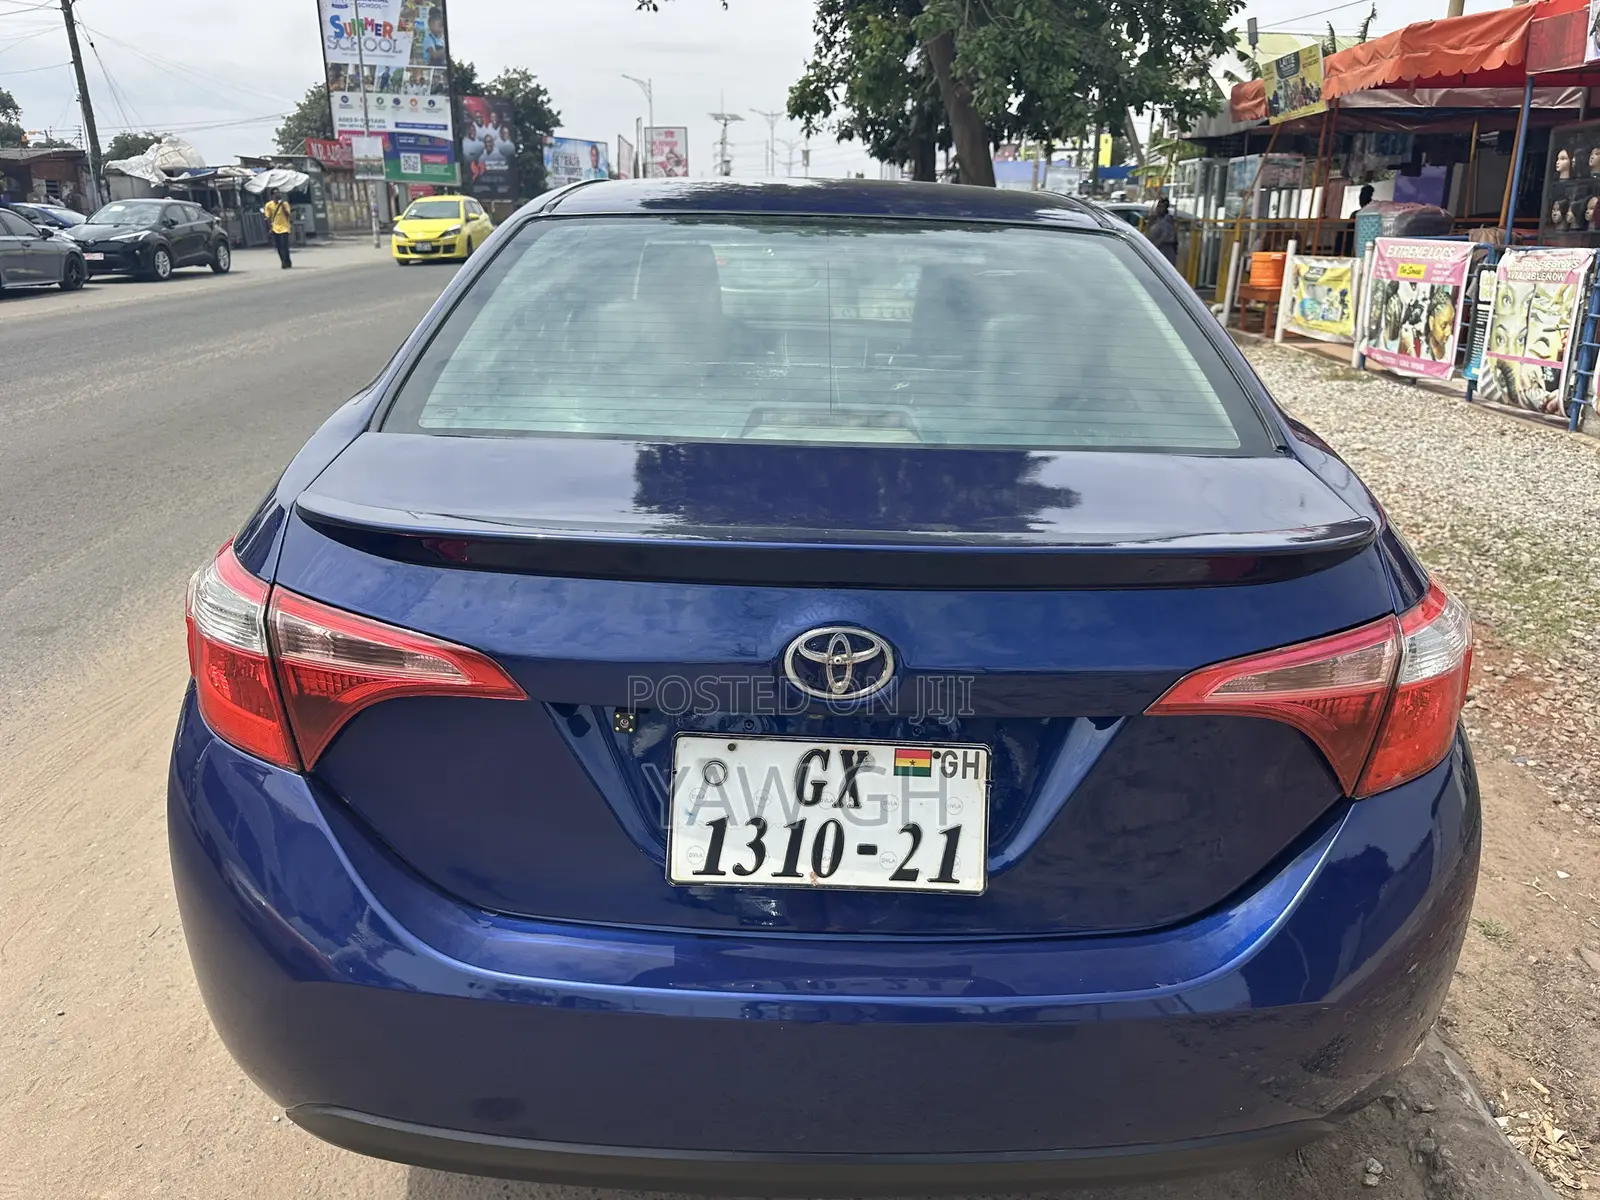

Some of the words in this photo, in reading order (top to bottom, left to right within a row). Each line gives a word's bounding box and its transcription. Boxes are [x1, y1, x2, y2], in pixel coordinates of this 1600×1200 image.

[329, 14, 394, 40] SUMMER
[795, 748, 869, 809] GX
[941, 750, 980, 779] GH
